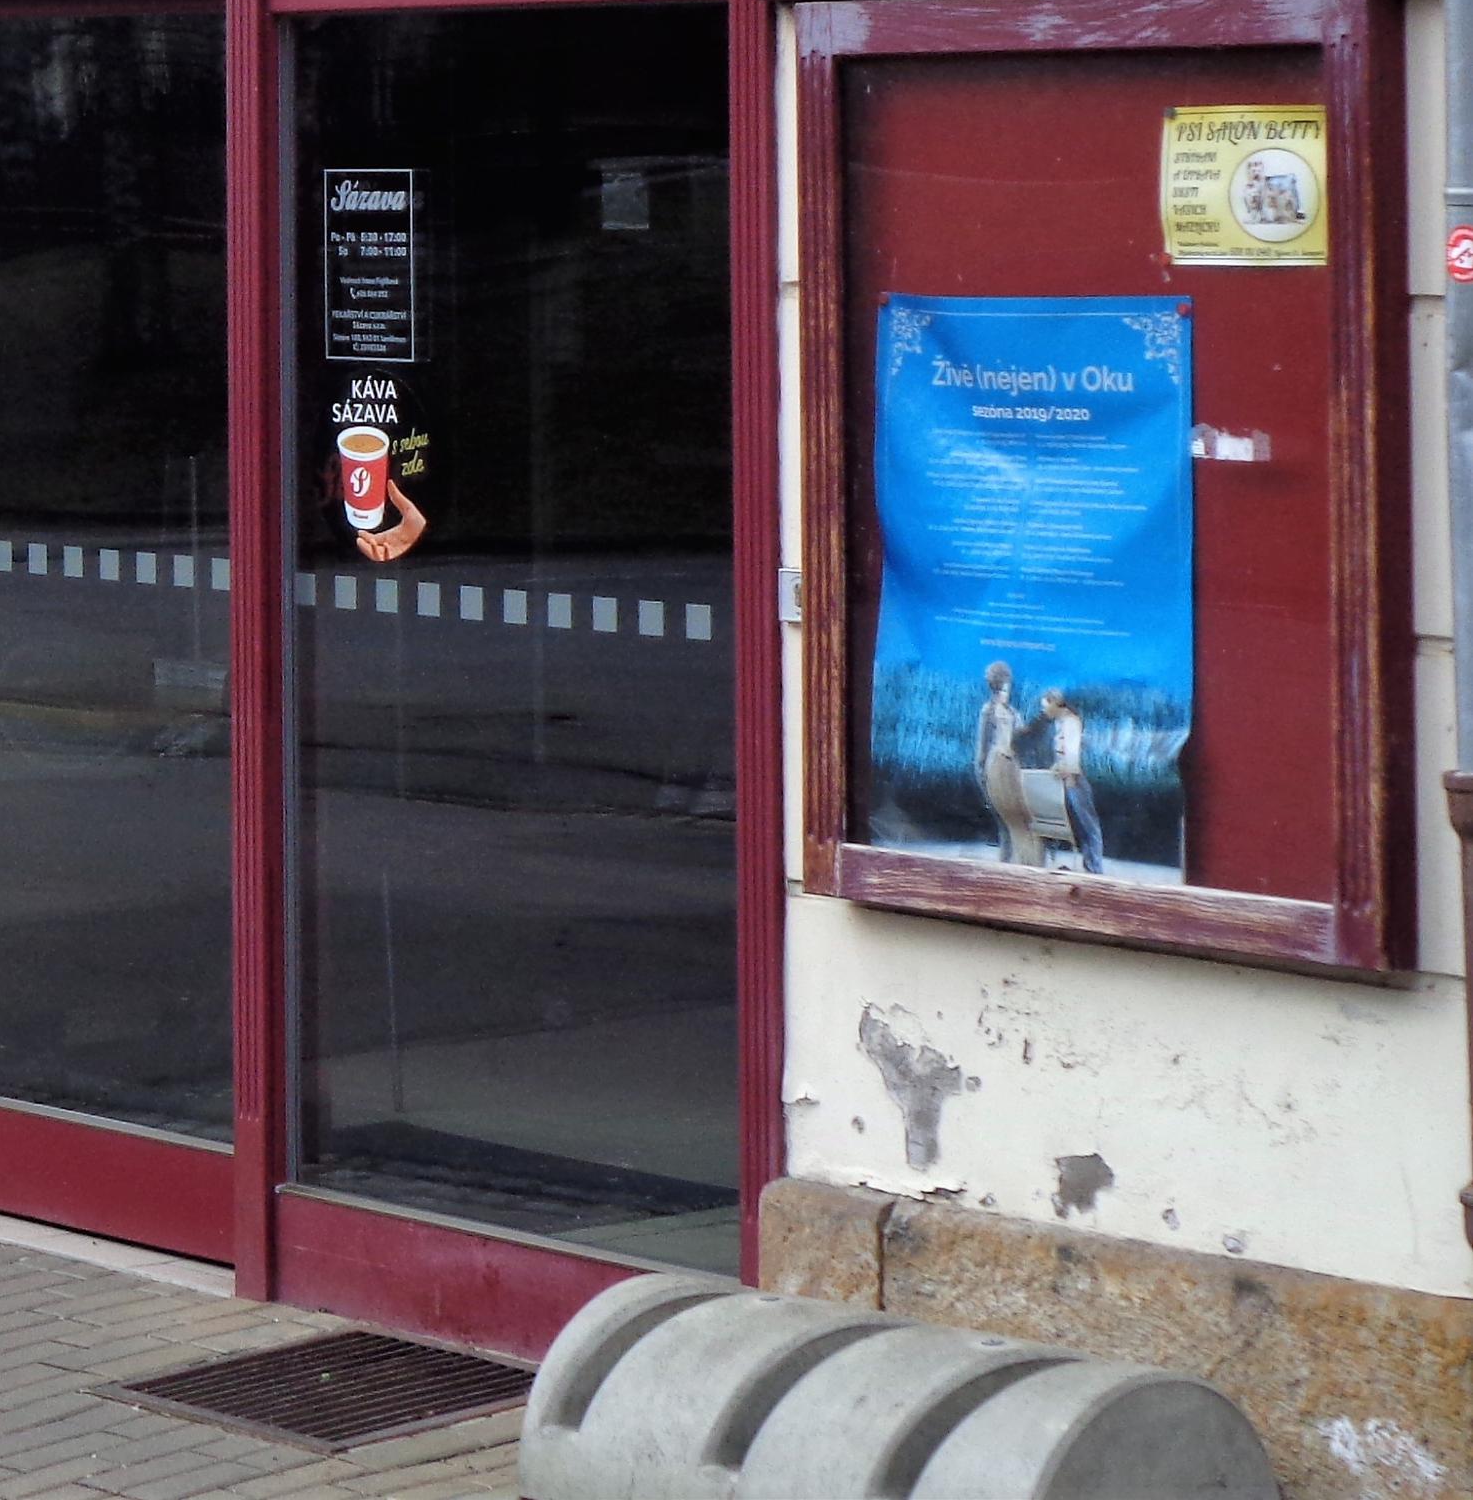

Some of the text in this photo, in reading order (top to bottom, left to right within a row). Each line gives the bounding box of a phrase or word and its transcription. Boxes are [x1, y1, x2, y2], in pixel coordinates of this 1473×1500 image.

[1177, 114, 1322, 145] PSÍ SALÓN BETTY
[330, 180, 408, 211] Sázava
[352, 376, 397, 399] KÁVA
[977, 364, 1057, 396] (nejen)
[1065, 371, 1077, 390] v
[1081, 365, 1134, 392] Oku
[332, 399, 398, 424] SÁZAVA
[400, 428, 429, 452] sebou
[402, 451, 425, 477] zde
